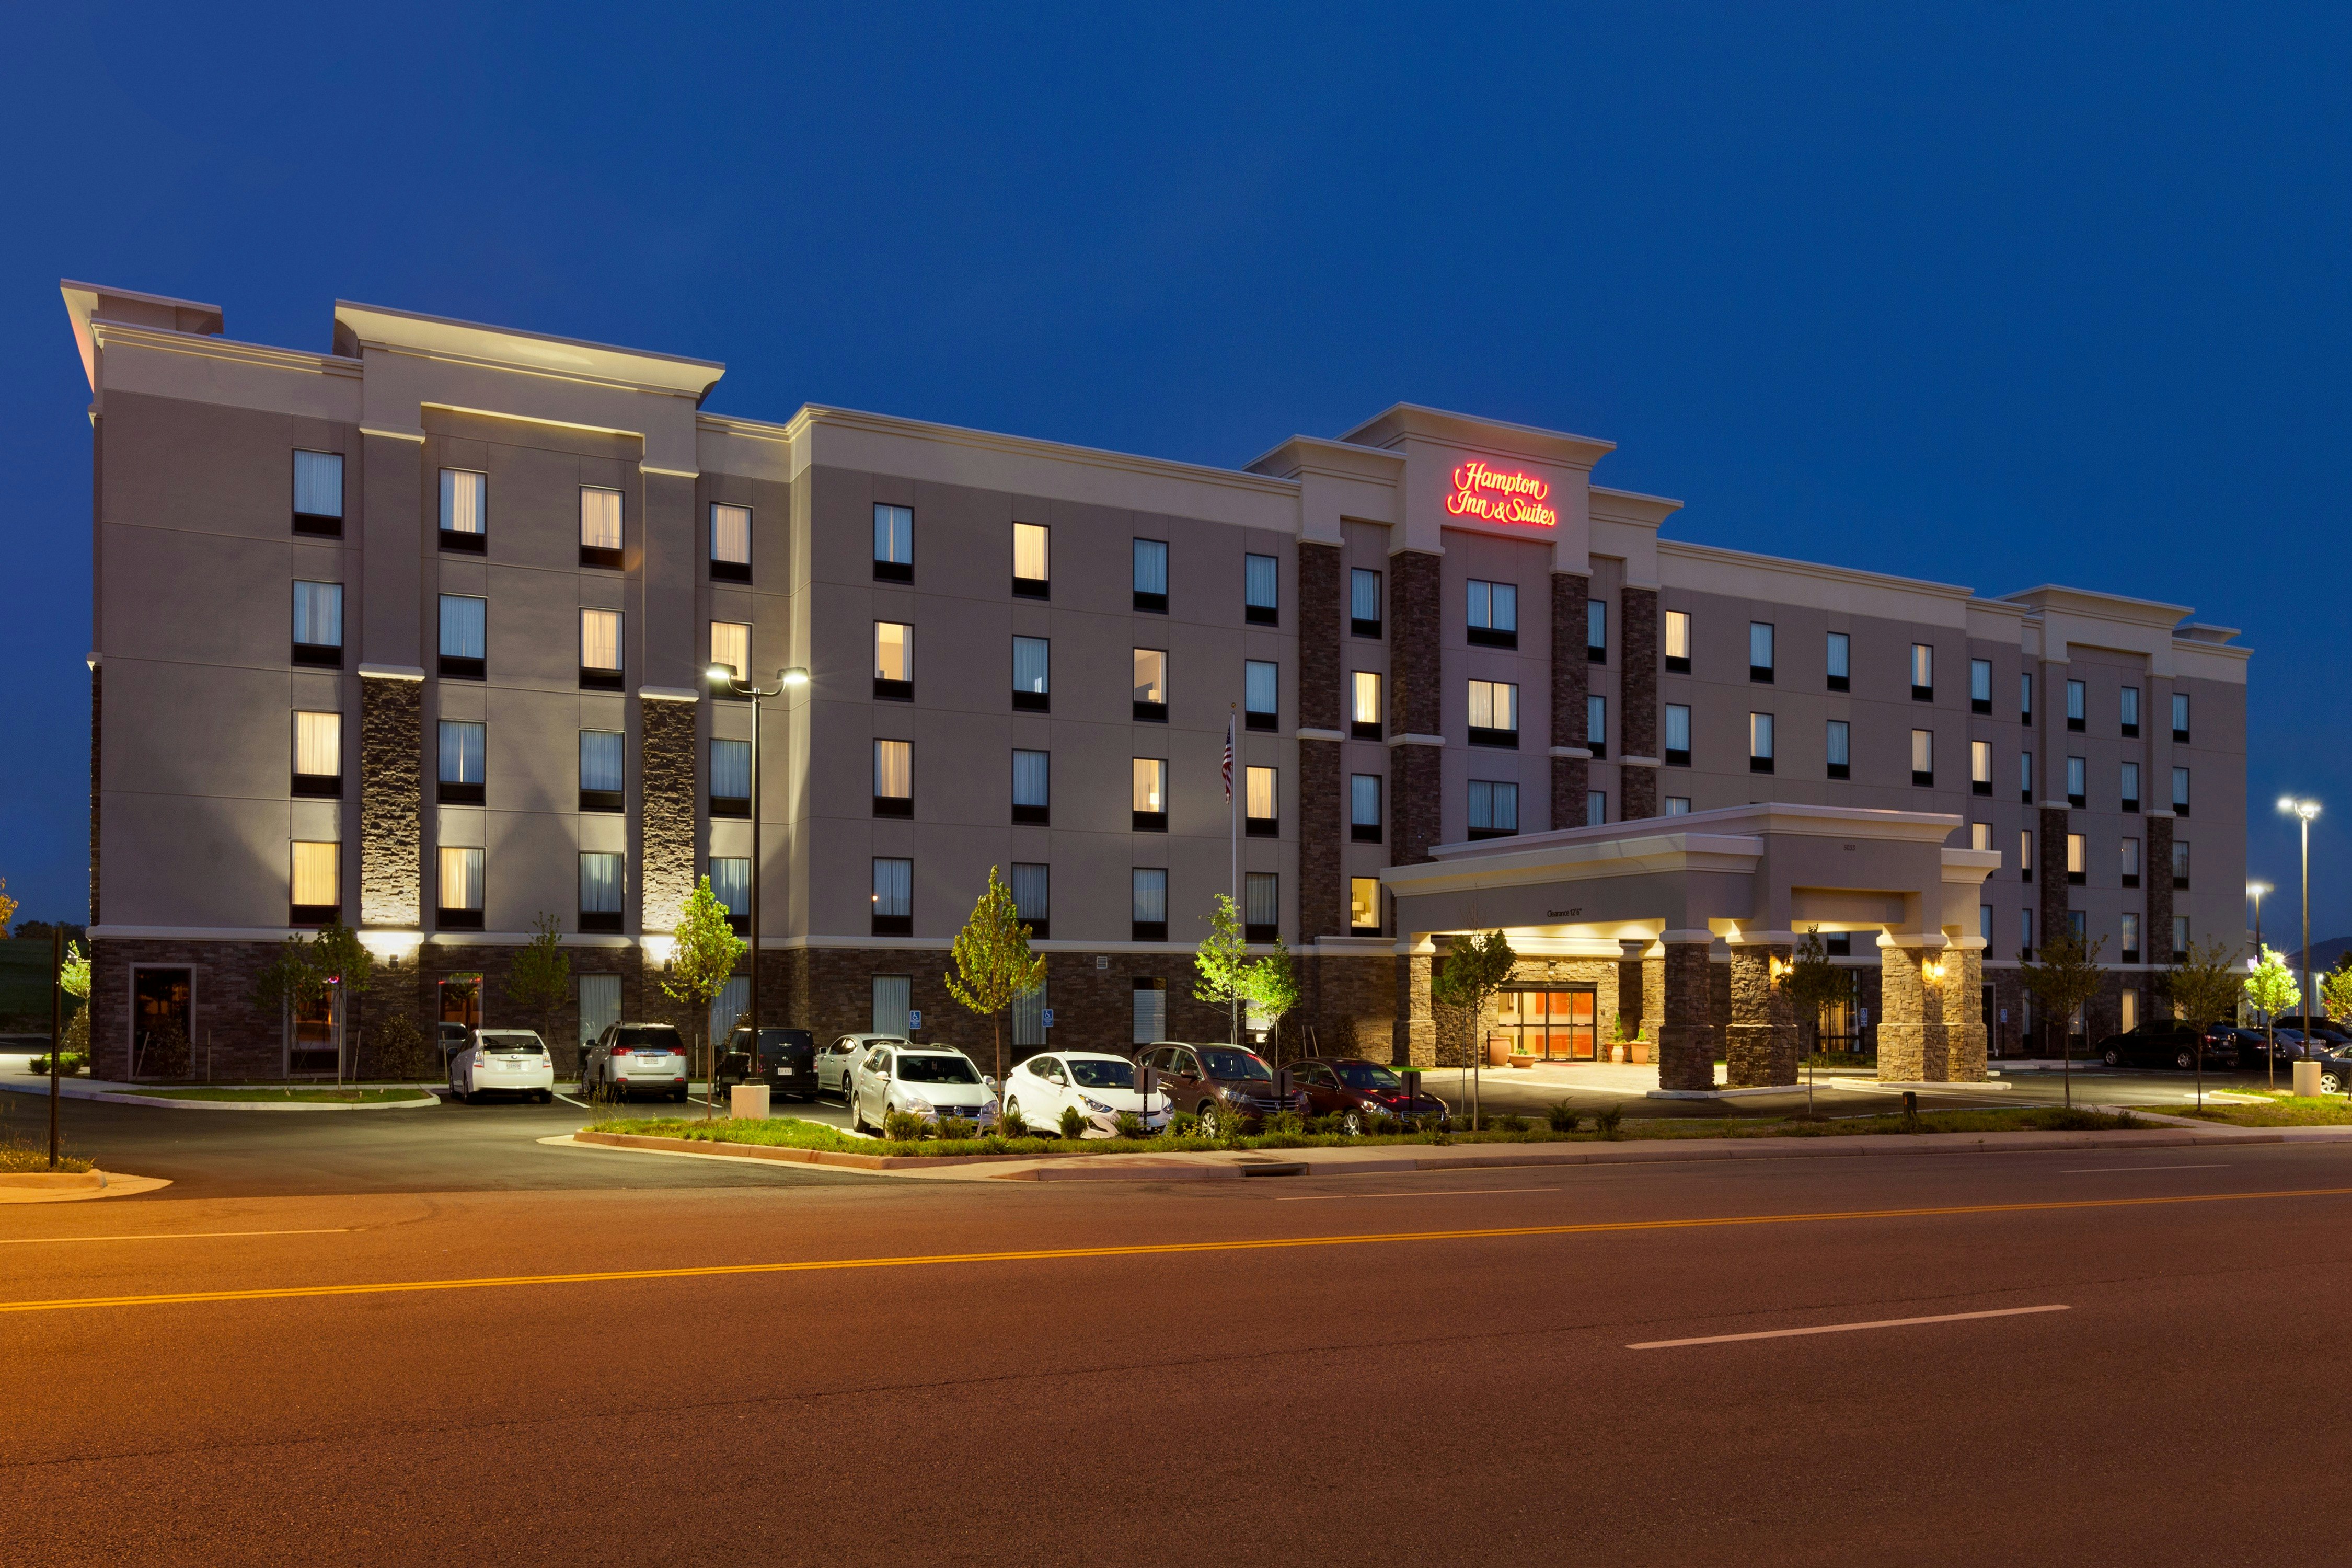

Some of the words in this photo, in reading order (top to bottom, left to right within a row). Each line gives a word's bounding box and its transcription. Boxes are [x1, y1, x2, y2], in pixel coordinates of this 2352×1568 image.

[1454, 463, 1547, 500] Hampton
[1446, 491, 1494, 519] Inn
[1494, 501, 1508, 523] &
[1506, 498, 1555, 526] Suites
